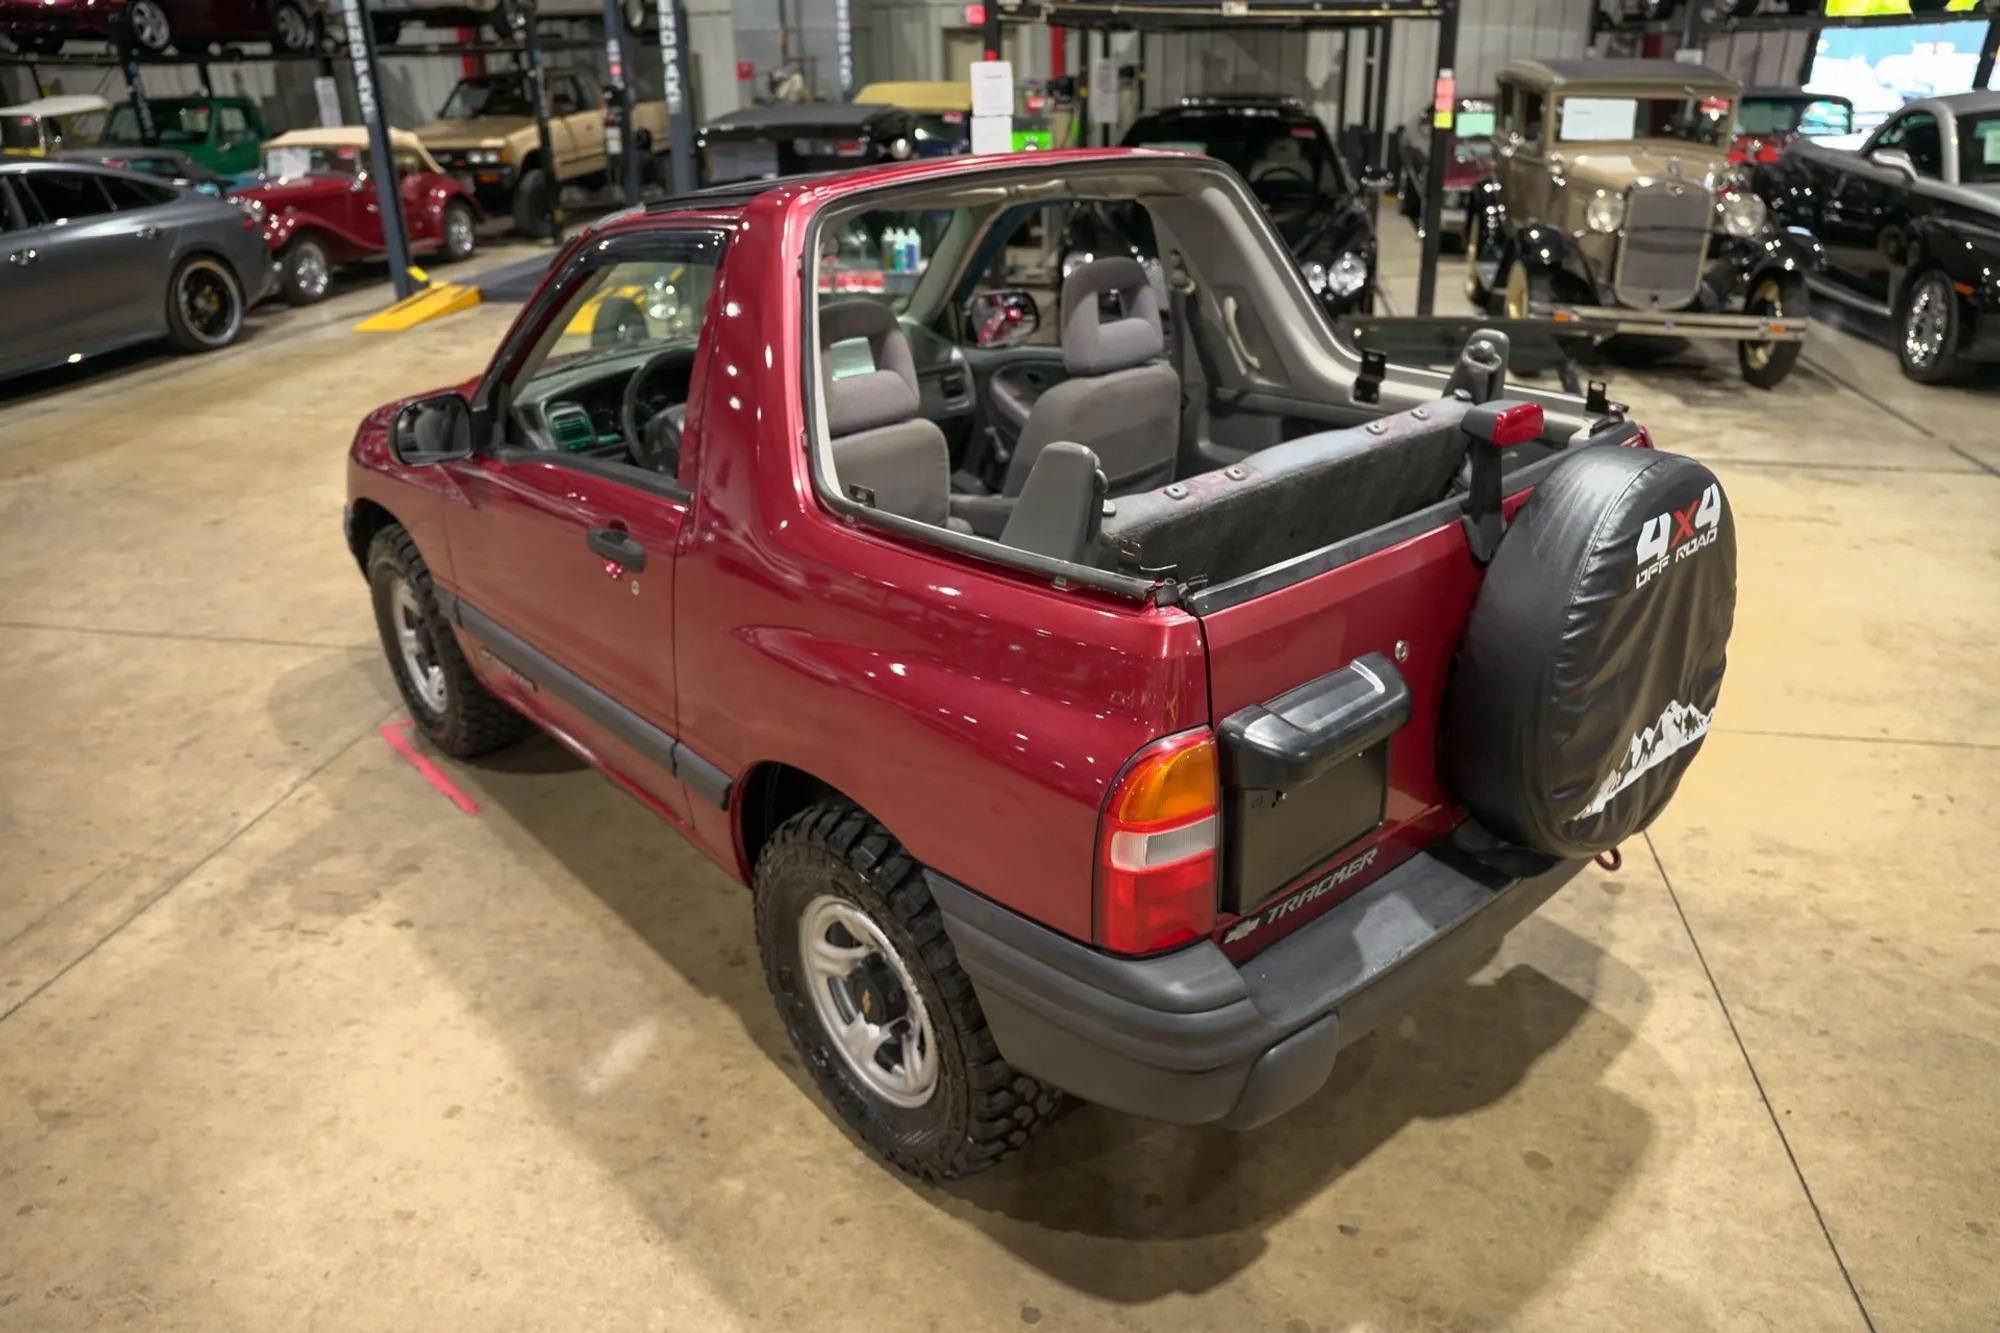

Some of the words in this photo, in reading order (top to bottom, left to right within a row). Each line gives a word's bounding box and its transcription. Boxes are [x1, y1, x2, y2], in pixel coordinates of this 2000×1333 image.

[1636, 554, 1670, 589] OFF
[1675, 527, 1718, 563] ROAD
[1267, 847, 1378, 925] TRACKER
